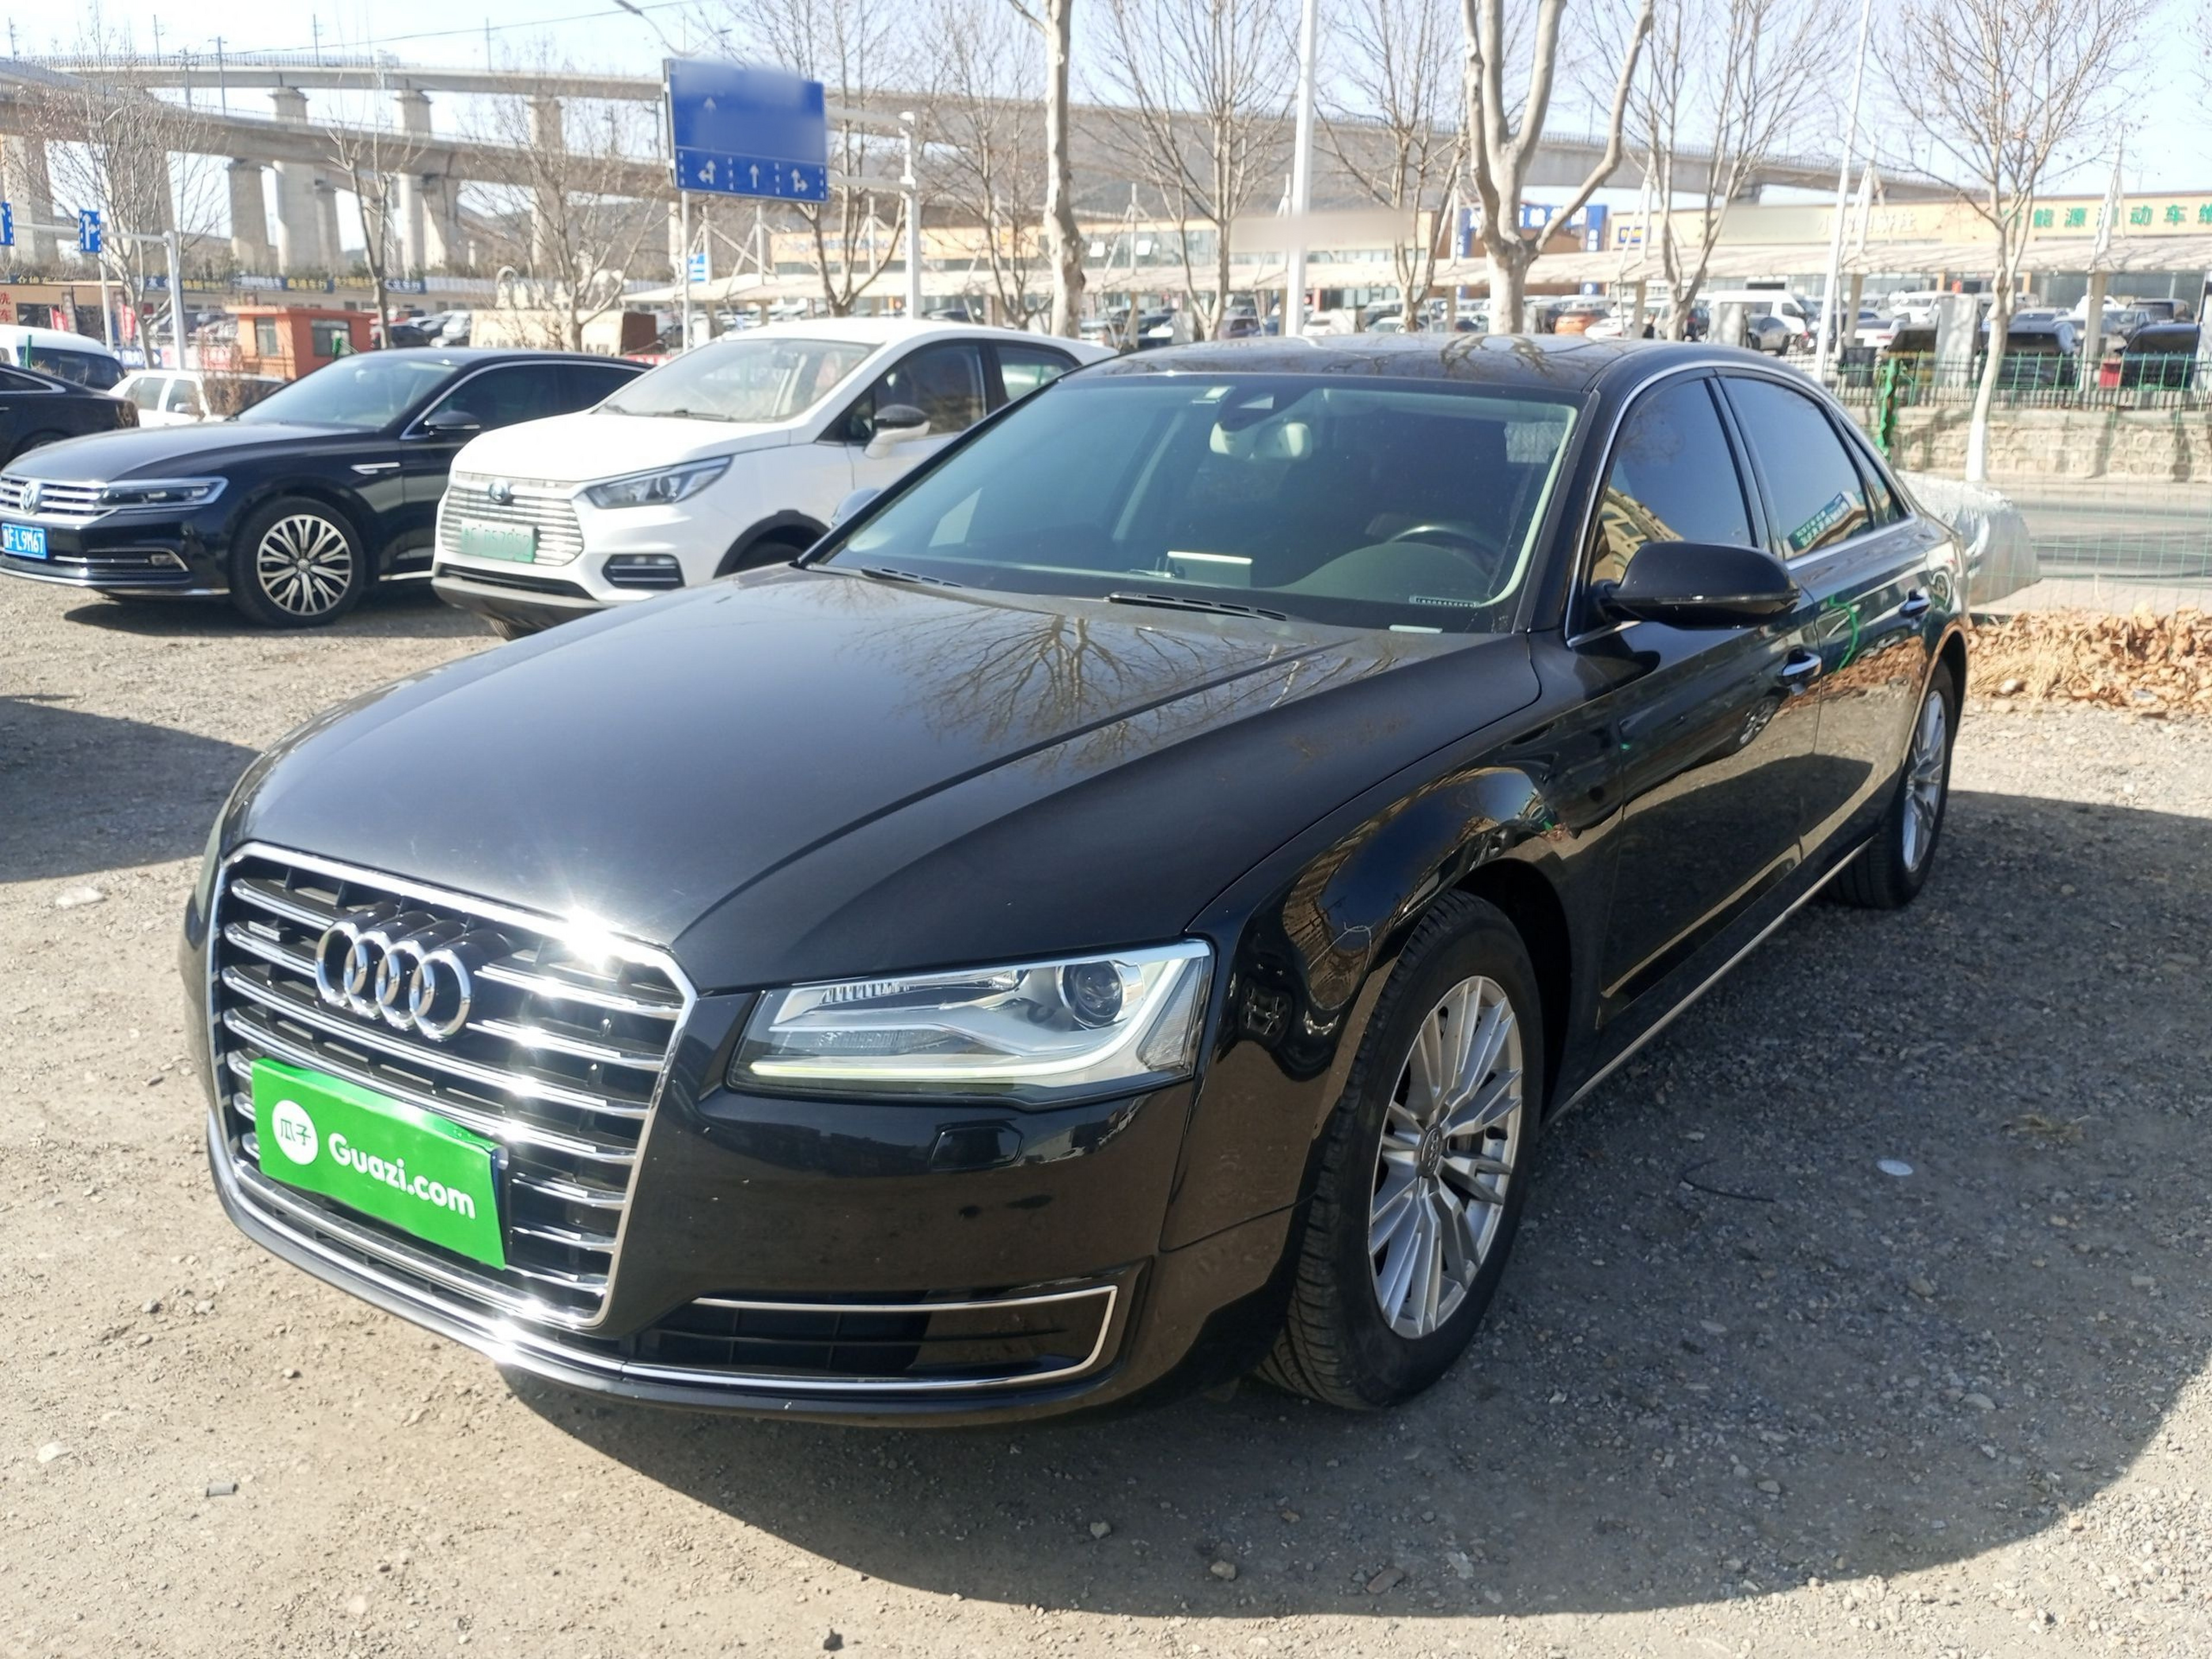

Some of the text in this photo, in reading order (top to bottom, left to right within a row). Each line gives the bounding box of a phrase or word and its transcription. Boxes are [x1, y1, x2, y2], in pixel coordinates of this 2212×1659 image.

[2002, 203, 2212, 229] 能源动车维
[280, 1118, 311, 1146] 瓜子
[328, 1132, 476, 1219] Guazi.com
